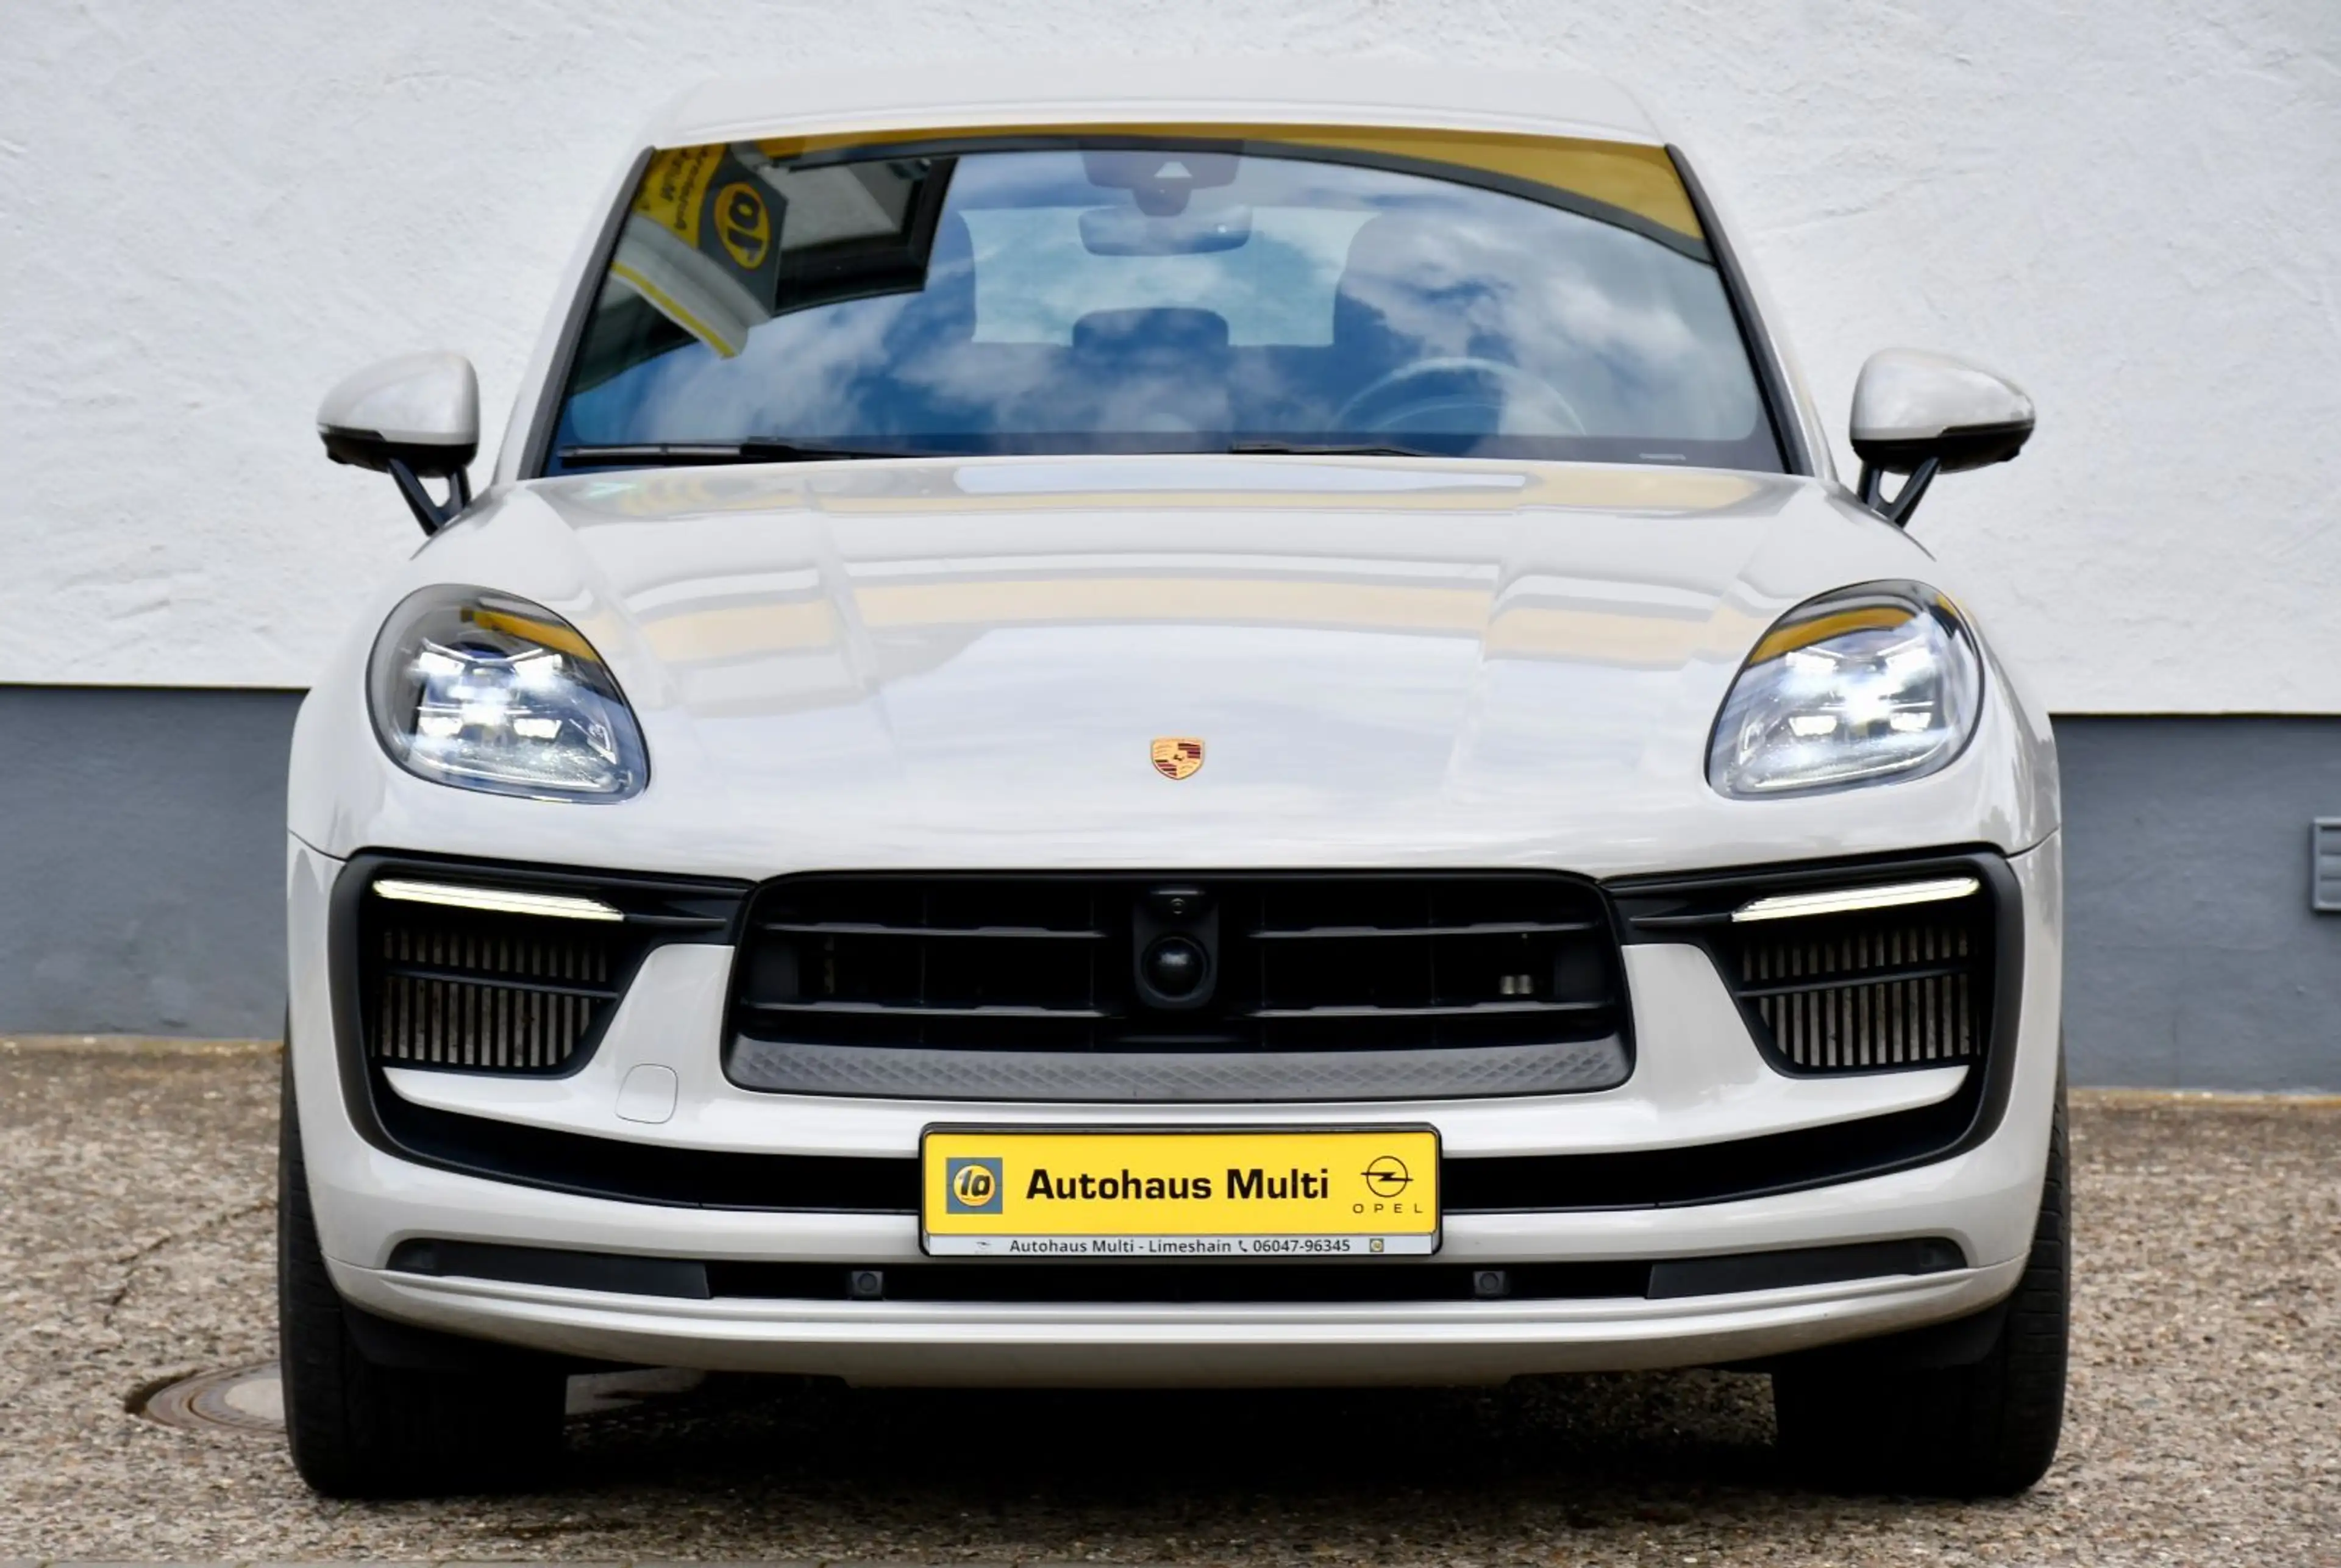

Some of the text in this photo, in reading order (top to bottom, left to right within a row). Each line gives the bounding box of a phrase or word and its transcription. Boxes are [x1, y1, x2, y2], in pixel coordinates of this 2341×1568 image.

[959, 1169, 991, 1197] 1a
[1025, 1168, 1328, 1200] Autohaus Multi
[1352, 1203, 1423, 1214] OPEL
[1010, 1239, 1088, 1253] Autohaus
[1092, 1239, 1134, 1253] Multi
[1149, 1239, 1231, 1253] Limeshain
[1253, 1239, 1351, 1253] 06047-96345
